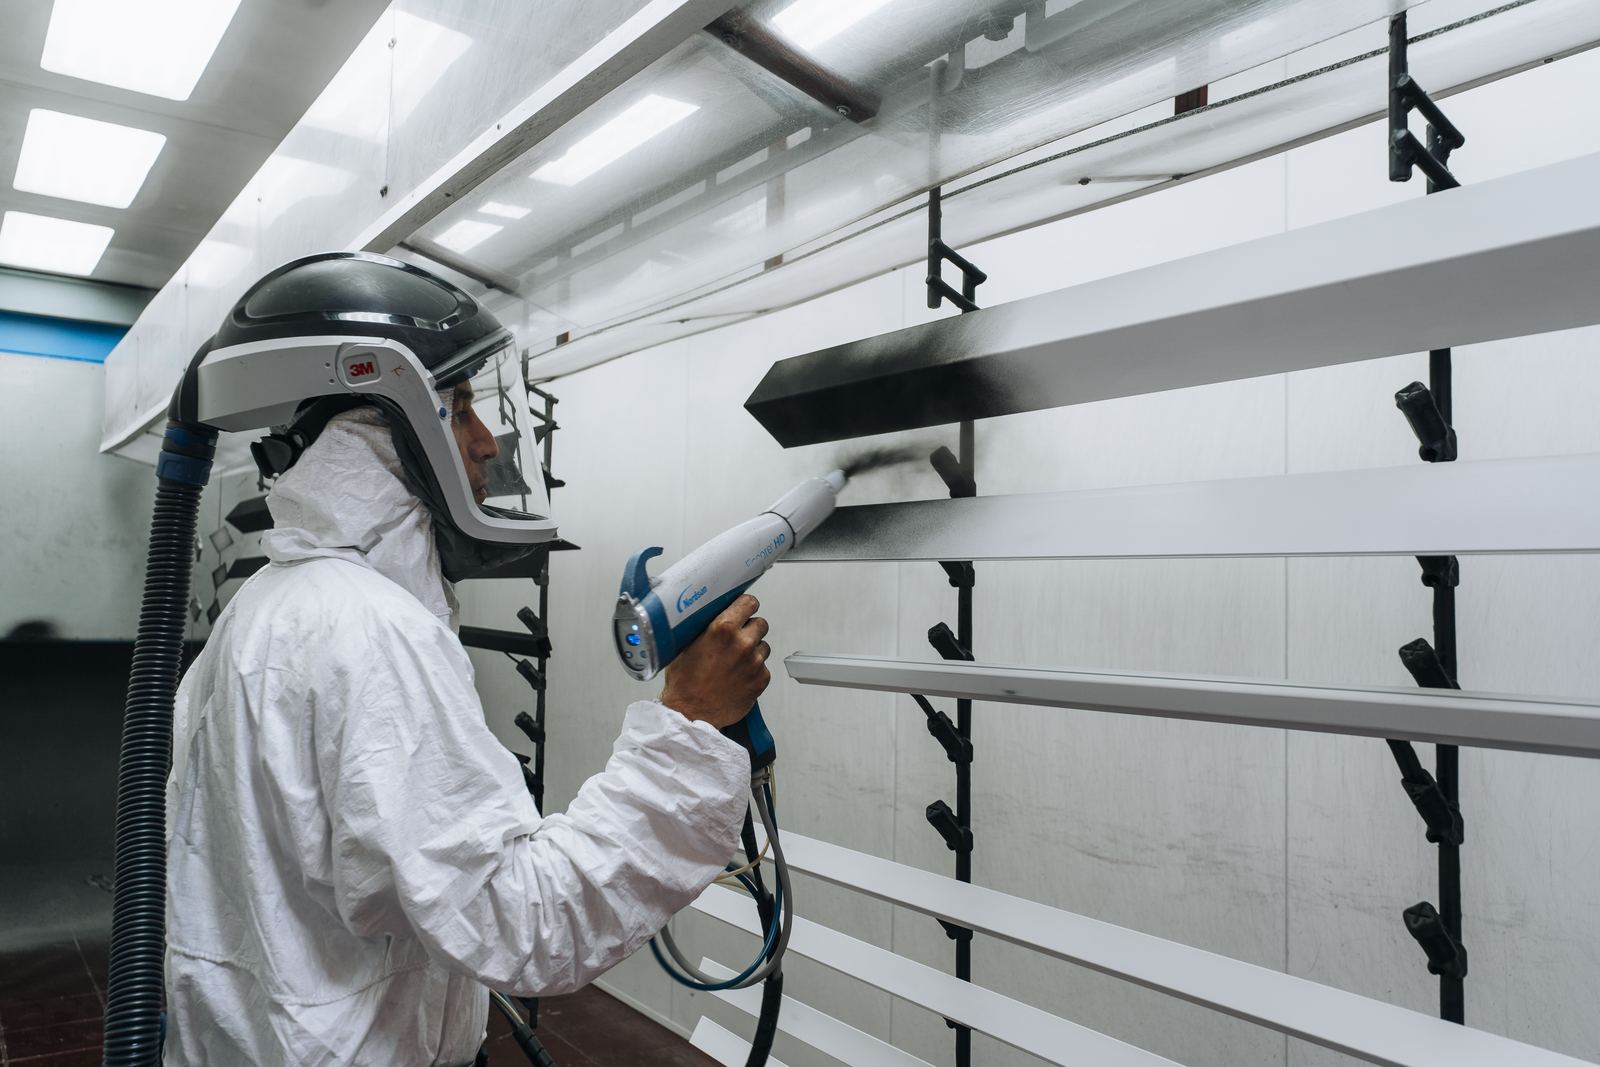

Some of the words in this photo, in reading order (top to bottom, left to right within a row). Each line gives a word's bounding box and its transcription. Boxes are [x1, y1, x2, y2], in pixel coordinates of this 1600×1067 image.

[350, 361, 375, 377] 3M
[773, 532, 786, 549] HD
[683, 585, 708, 609] Nordson
